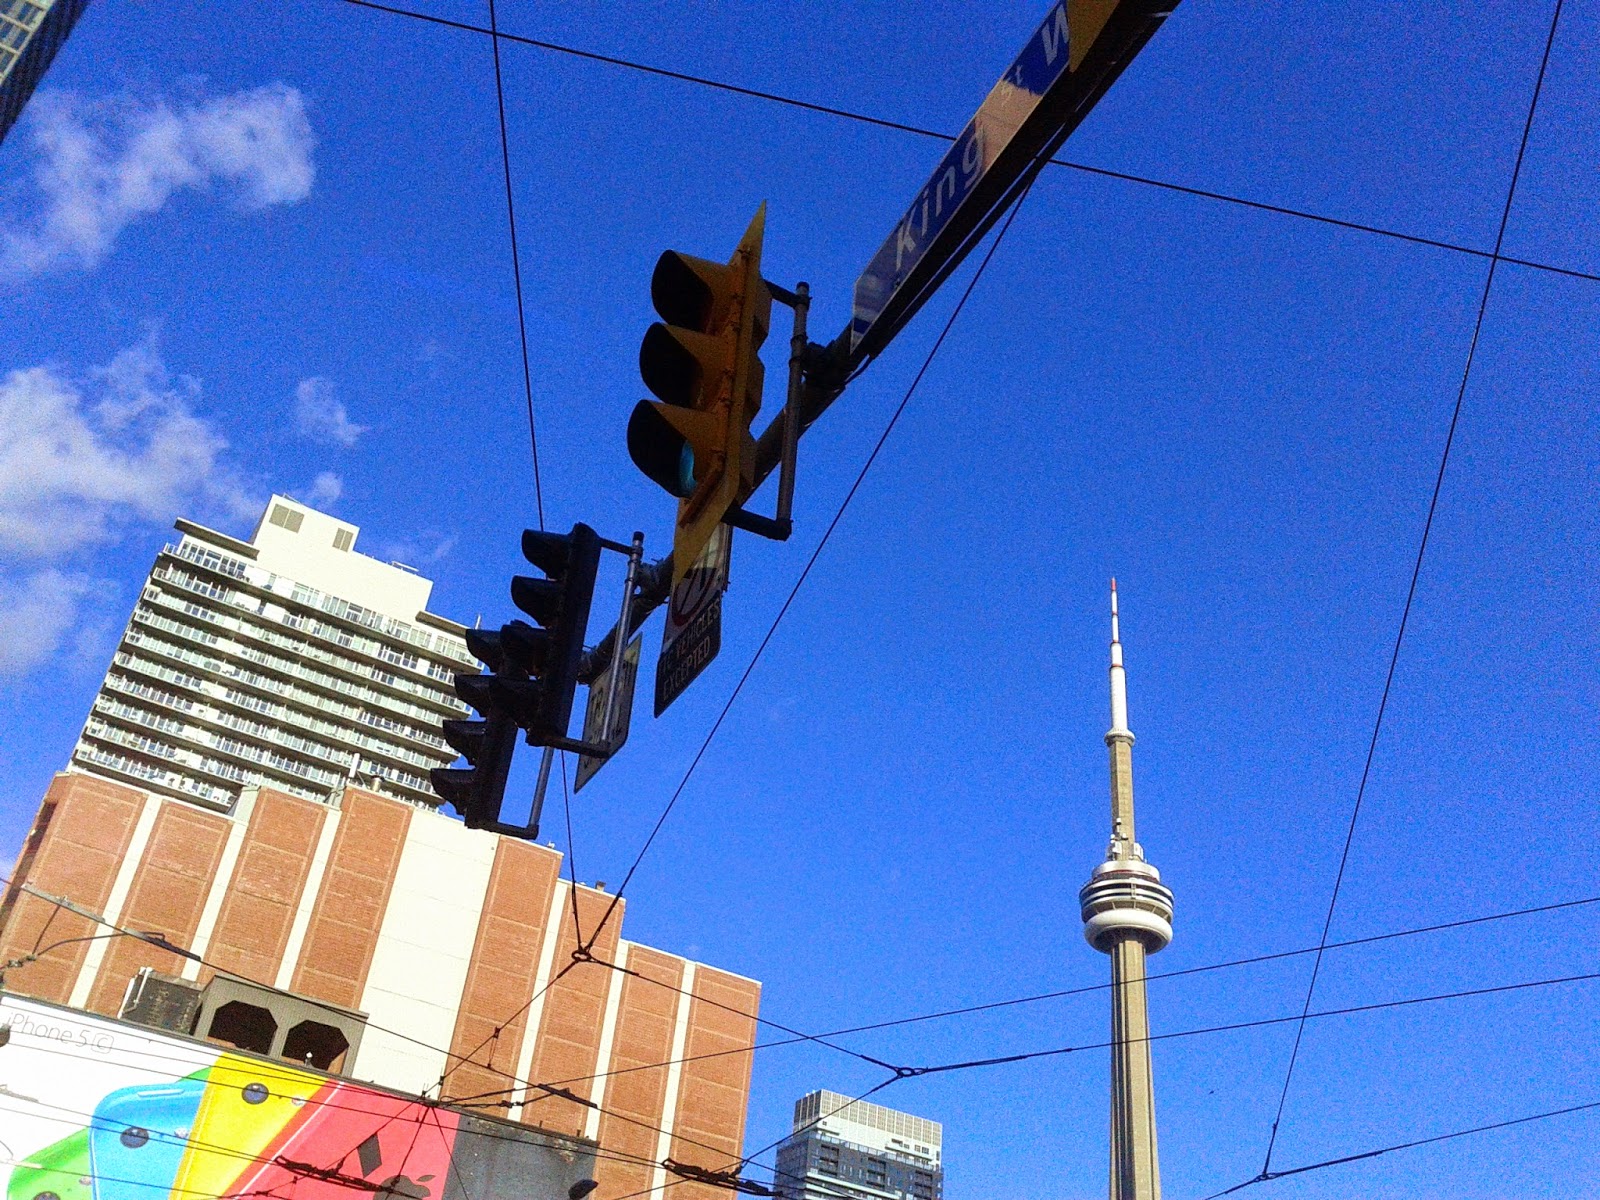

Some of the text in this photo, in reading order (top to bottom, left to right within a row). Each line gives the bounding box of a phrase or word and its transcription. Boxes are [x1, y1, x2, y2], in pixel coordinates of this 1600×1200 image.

[895, 124, 985, 272] King
[675, 597, 720, 658] VEHICLES
[663, 635, 710, 701] EXCEPTED
[7, 1012, 73, 1044] iPhone
